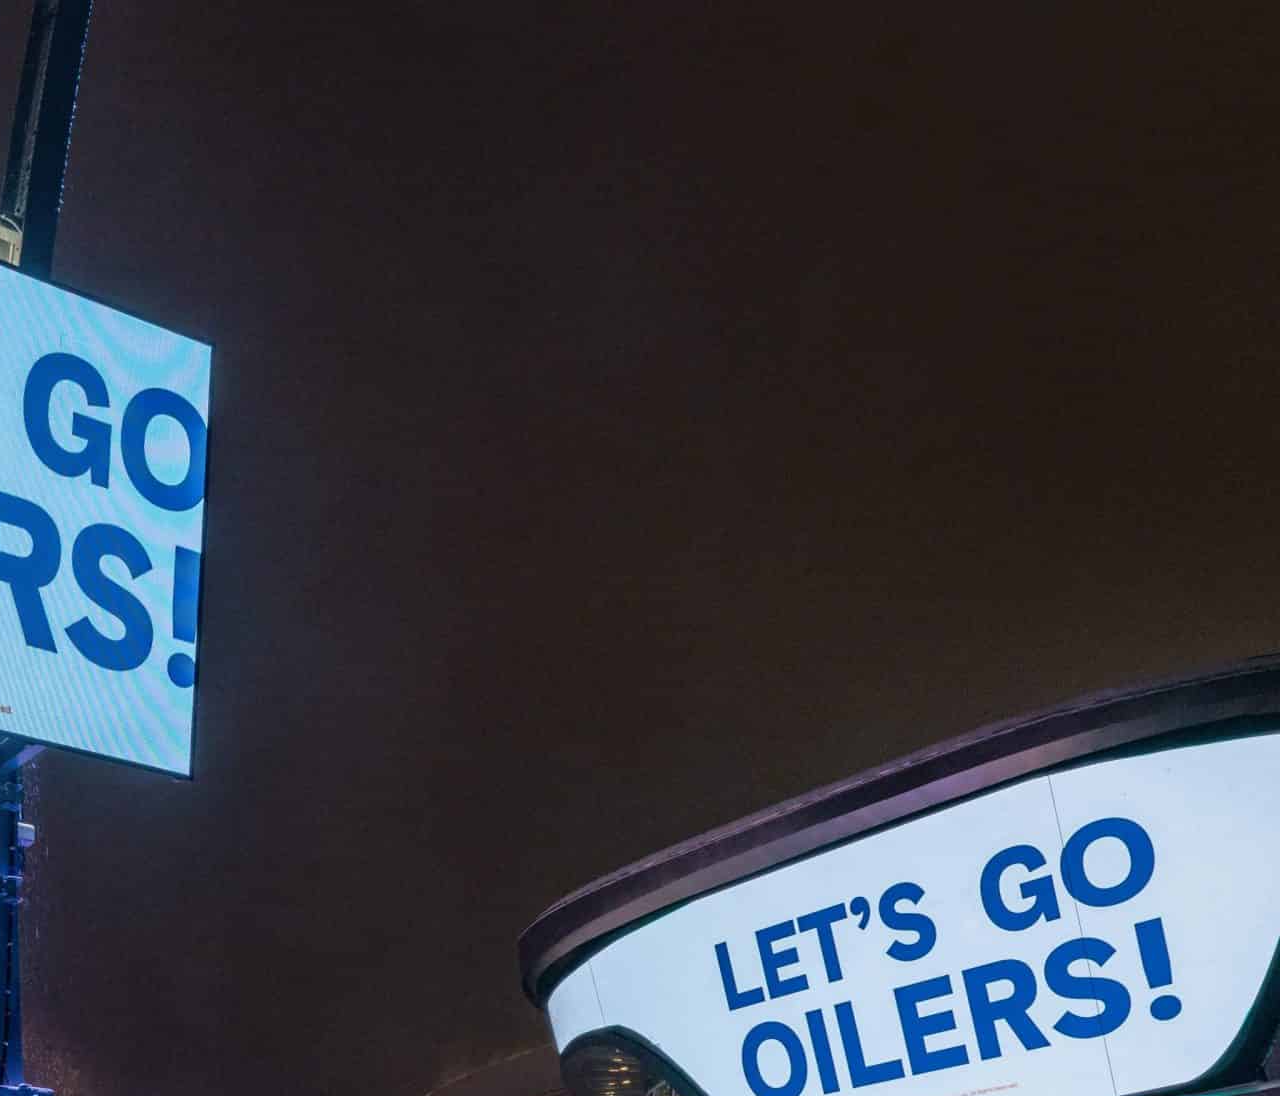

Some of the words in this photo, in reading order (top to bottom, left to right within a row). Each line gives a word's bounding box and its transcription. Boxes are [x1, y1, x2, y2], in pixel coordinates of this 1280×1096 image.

[22, 351, 208, 513] GO
[714, 881, 938, 1012] LET'S
[979, 816, 1156, 933] GO
